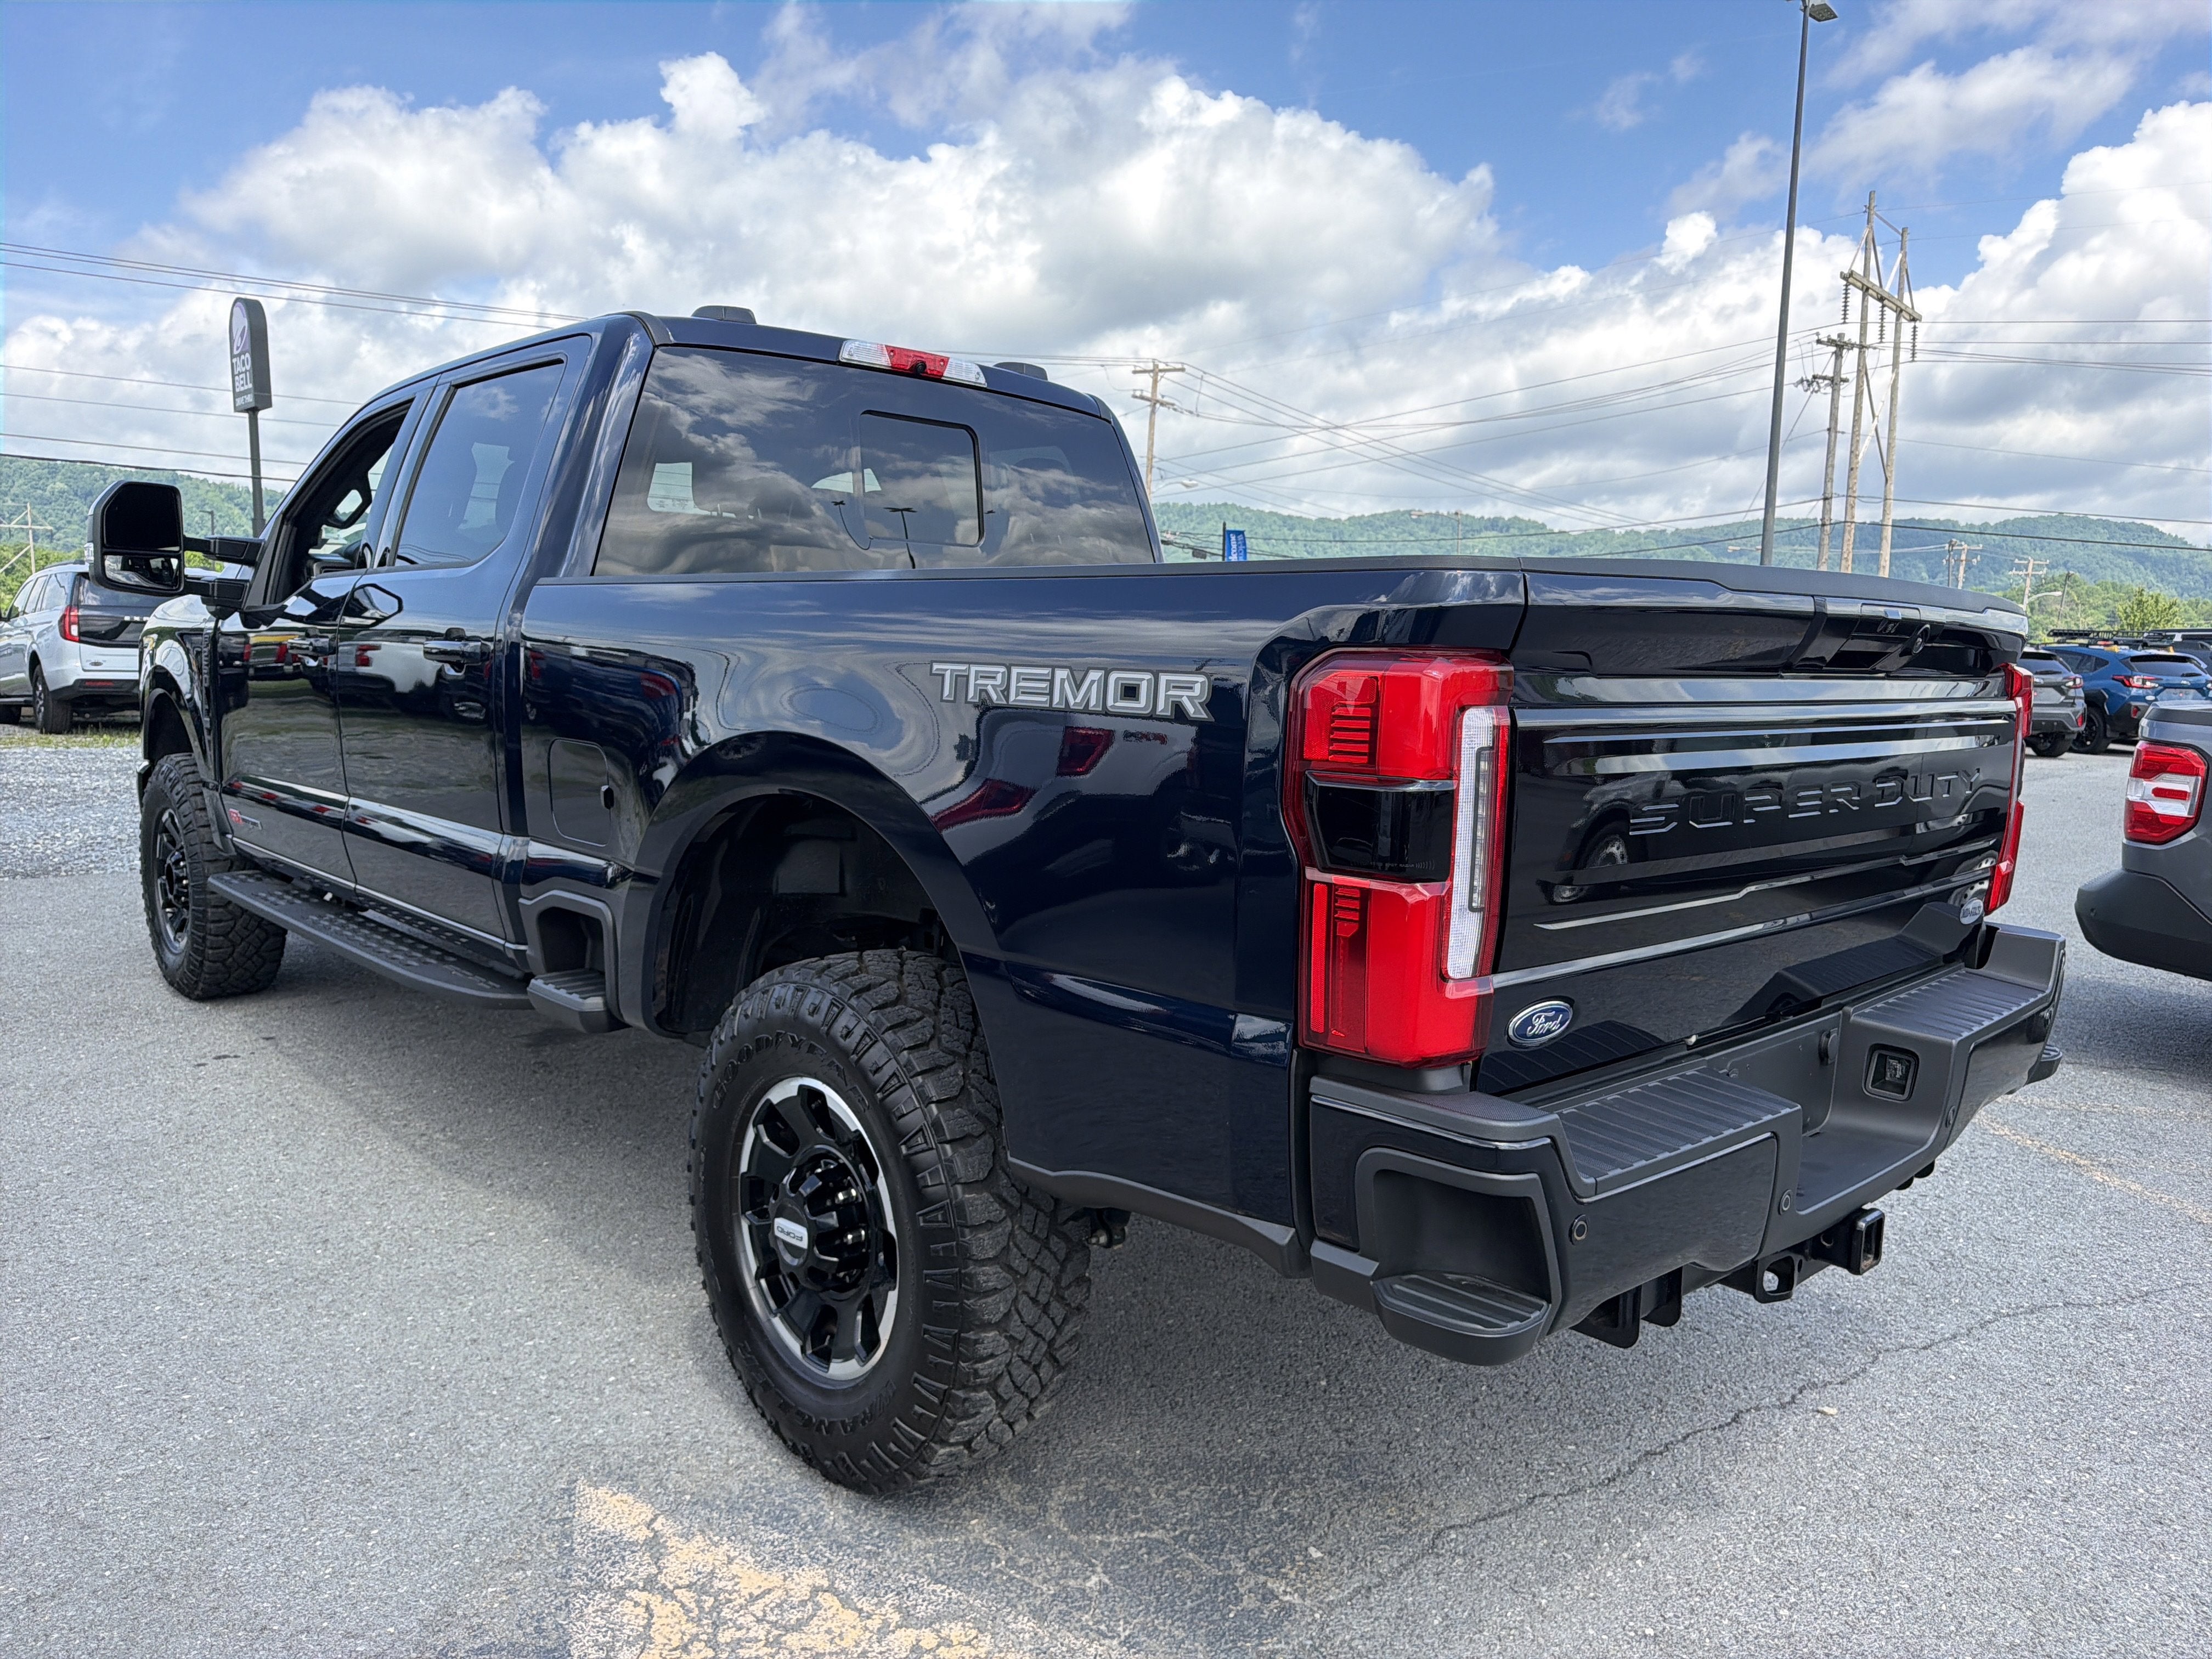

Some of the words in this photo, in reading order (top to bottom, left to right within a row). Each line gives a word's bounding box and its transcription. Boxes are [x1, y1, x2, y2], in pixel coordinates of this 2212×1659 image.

[233, 353, 251, 374] TACO
[235, 372, 252, 392] BELL
[931, 661, 1214, 721] TREMOR
[1629, 785, 1861, 835] SUPER
[1874, 768, 1979, 808] DUTY
[1527, 1011, 1562, 1036] Ford
[713, 1030, 870, 1113] GOODYEAR
[776, 1226, 803, 1242] FORD
